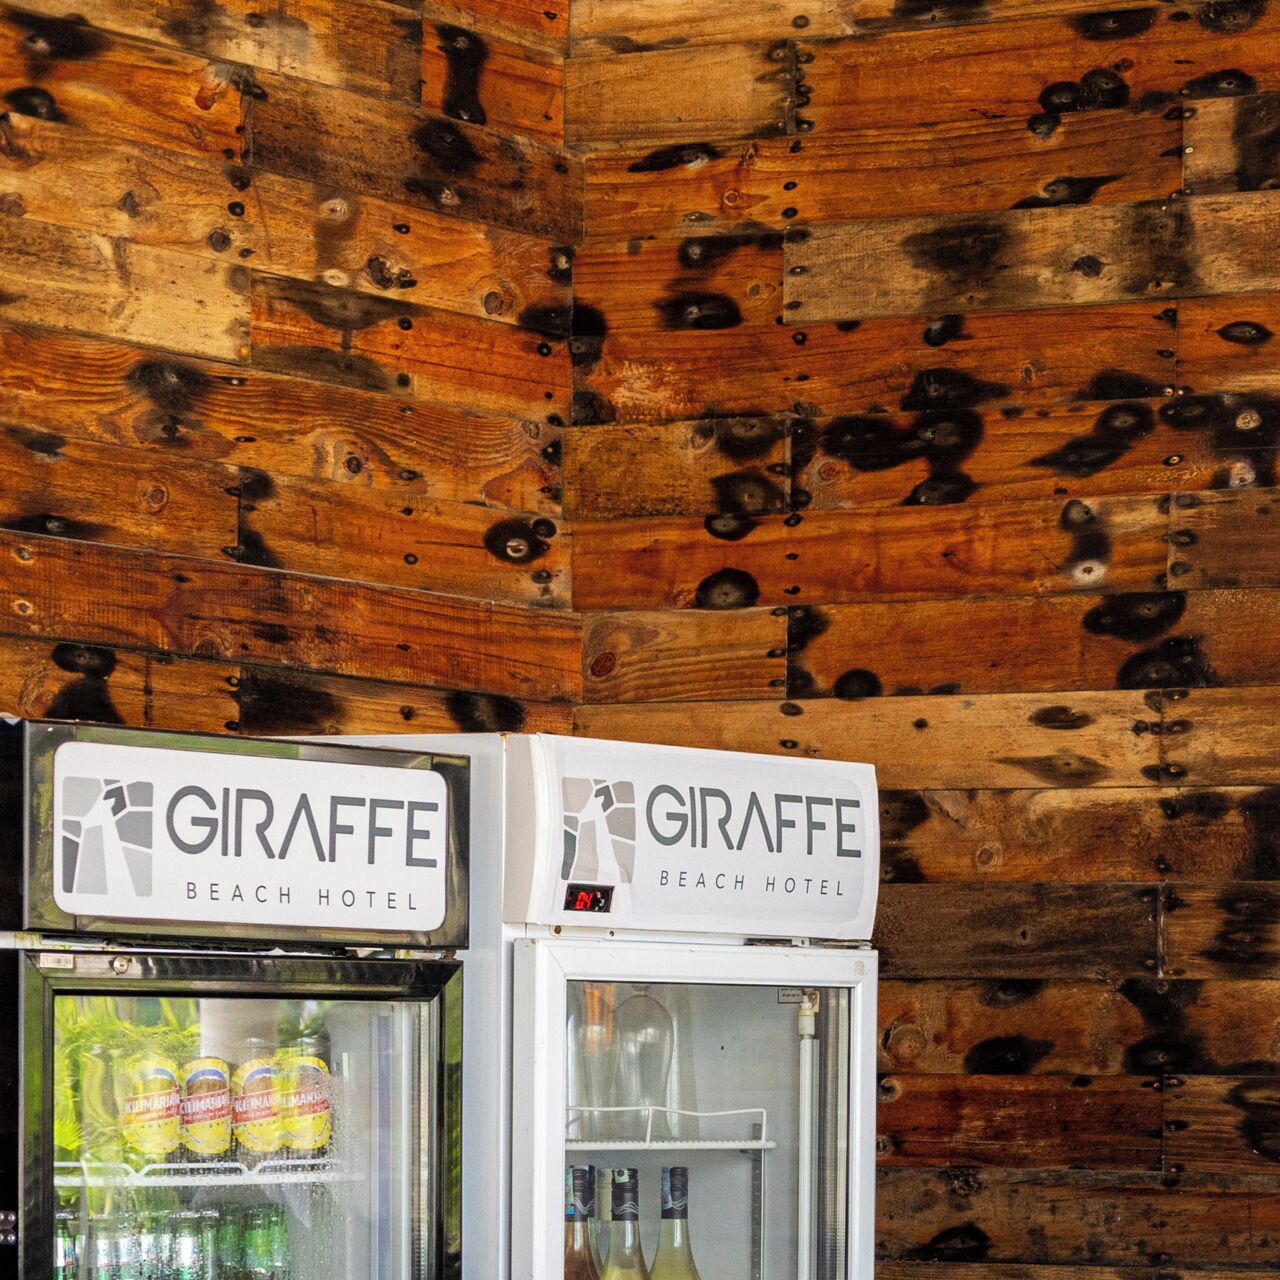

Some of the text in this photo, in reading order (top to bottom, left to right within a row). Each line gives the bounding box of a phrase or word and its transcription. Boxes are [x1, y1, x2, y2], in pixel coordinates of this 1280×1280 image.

[166, 785, 439, 868] GIRAFFE
[646, 784, 862, 858] GIRAFFE
[187, 882, 417, 910] BEACH HOTEL
[660, 871, 844, 896] BEACH HOTEL
